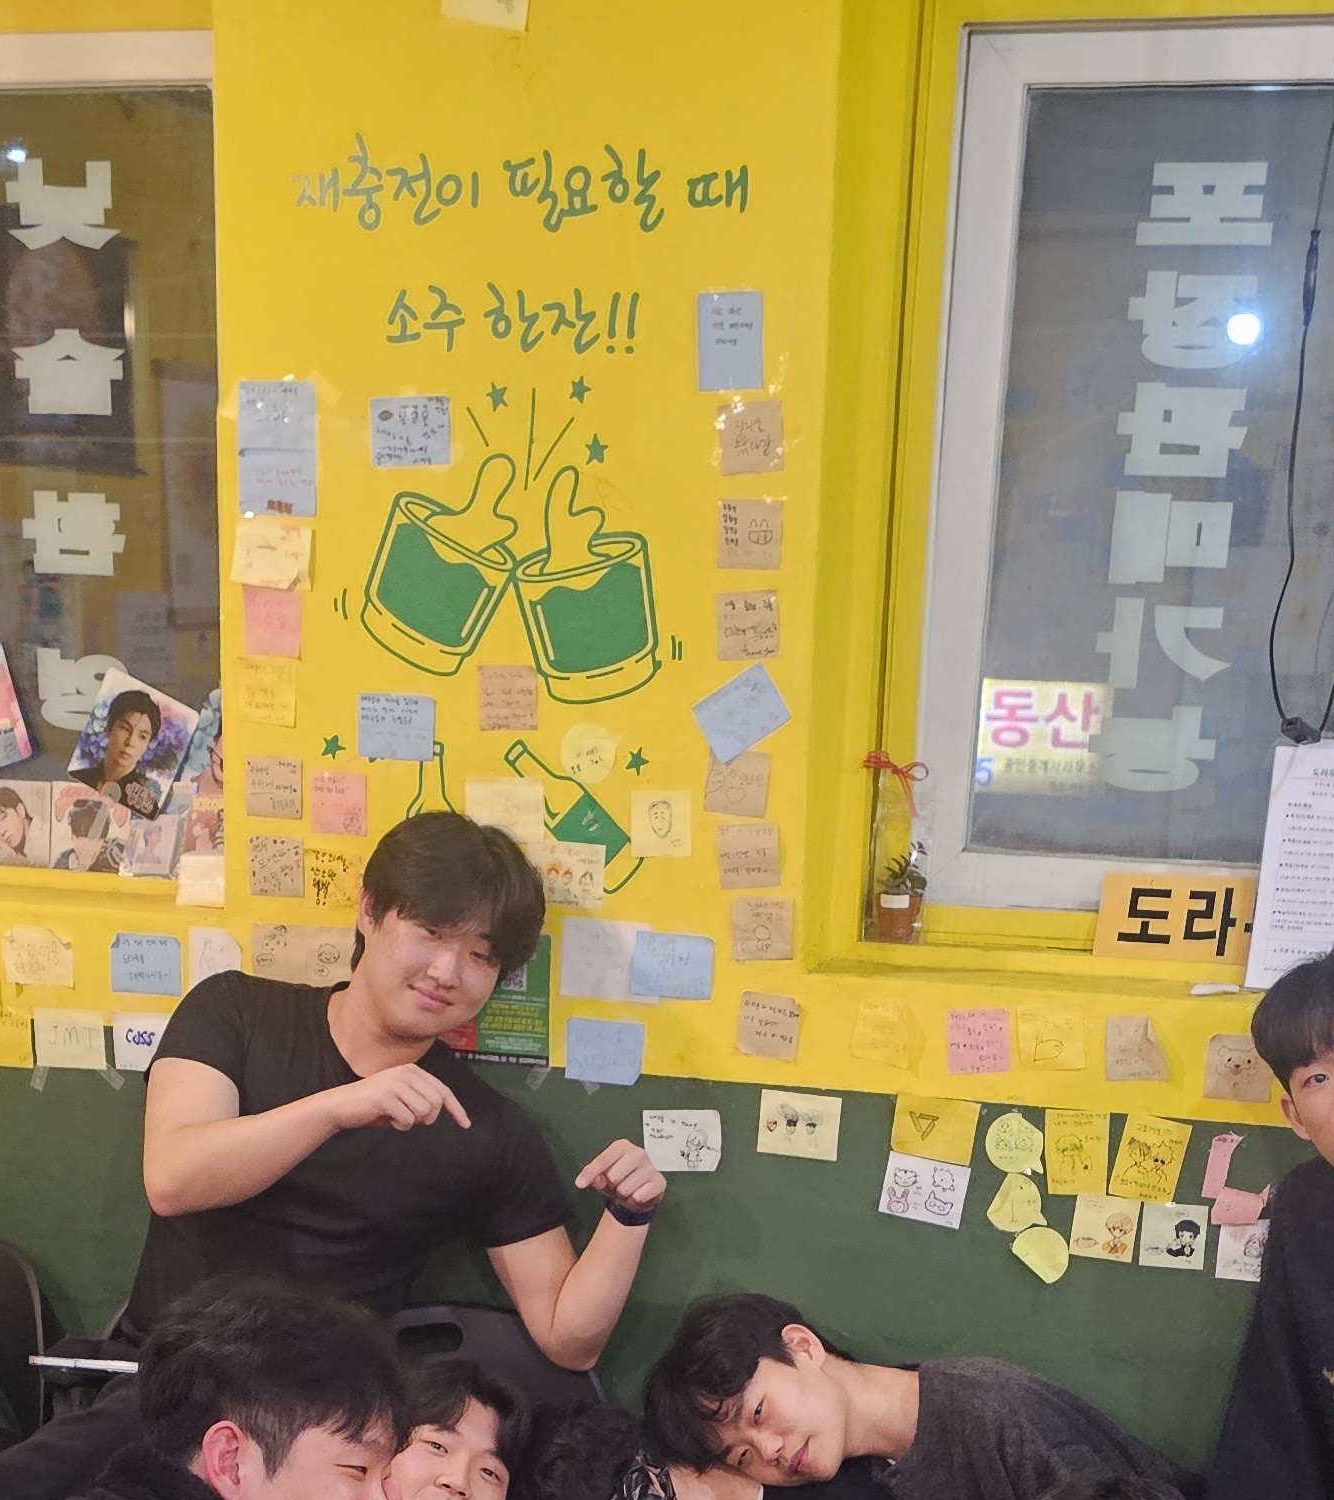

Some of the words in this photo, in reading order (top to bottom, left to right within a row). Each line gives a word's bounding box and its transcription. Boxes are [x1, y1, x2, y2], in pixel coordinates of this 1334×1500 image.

[292, 133, 480, 233] 재충전이
[503, 144, 667, 232] 필요할
[687, 165, 751, 214] 때
[386, 284, 466, 353] 소주
[483, 281, 641, 356] 한잔!!
[1116, 886, 1253, 957] 도라
